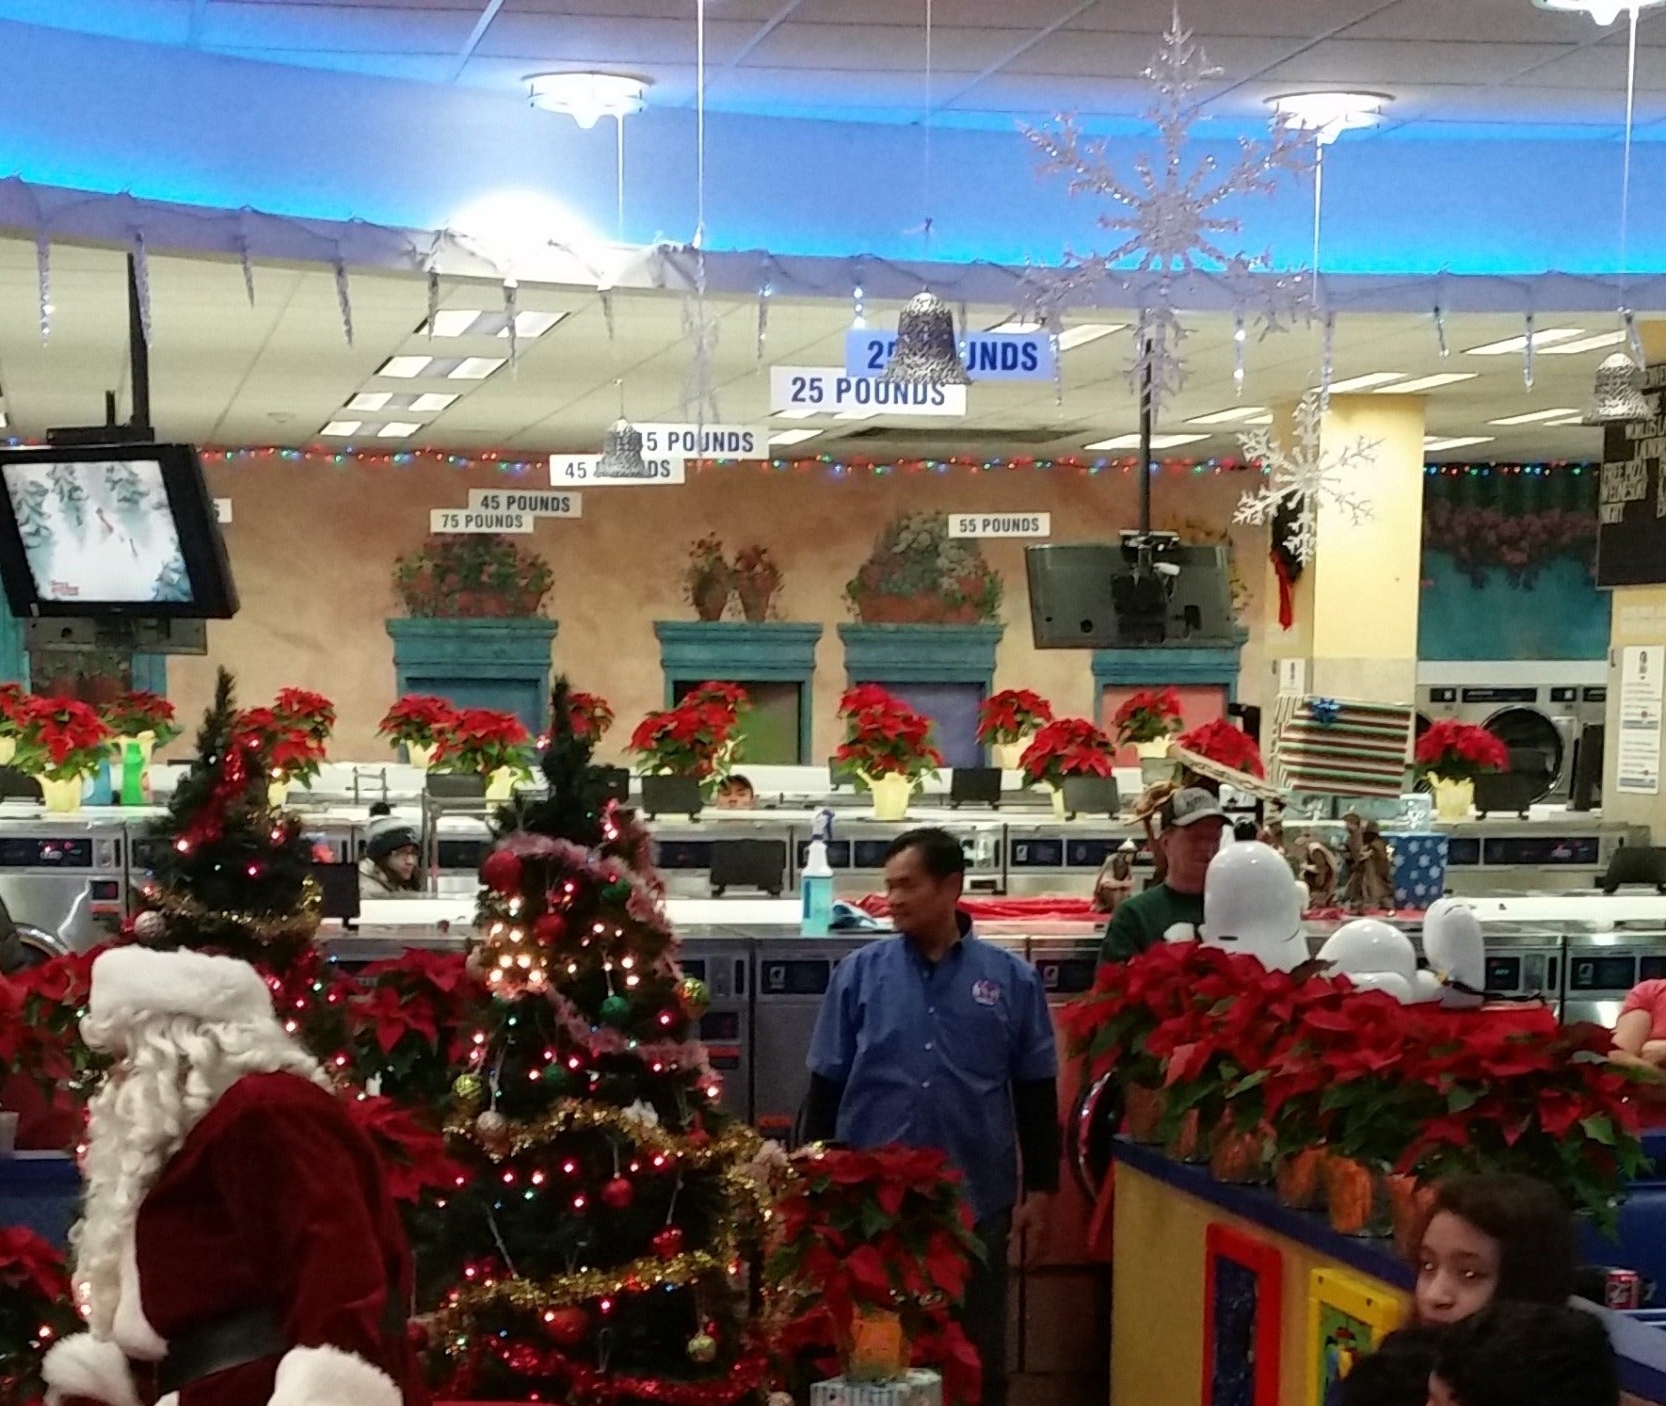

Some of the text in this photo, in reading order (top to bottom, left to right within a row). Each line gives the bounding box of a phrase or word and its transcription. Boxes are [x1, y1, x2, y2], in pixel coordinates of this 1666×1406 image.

[791, 377, 946, 406] 25 POUNDS
[668, 431, 754, 453] POUNDS
[564, 462, 588, 479] 45
[480, 494, 571, 512] 45 POUNDS
[440, 513, 524, 529] 75 POUNDS
[959, 517, 1040, 533] 55 POUNDS
